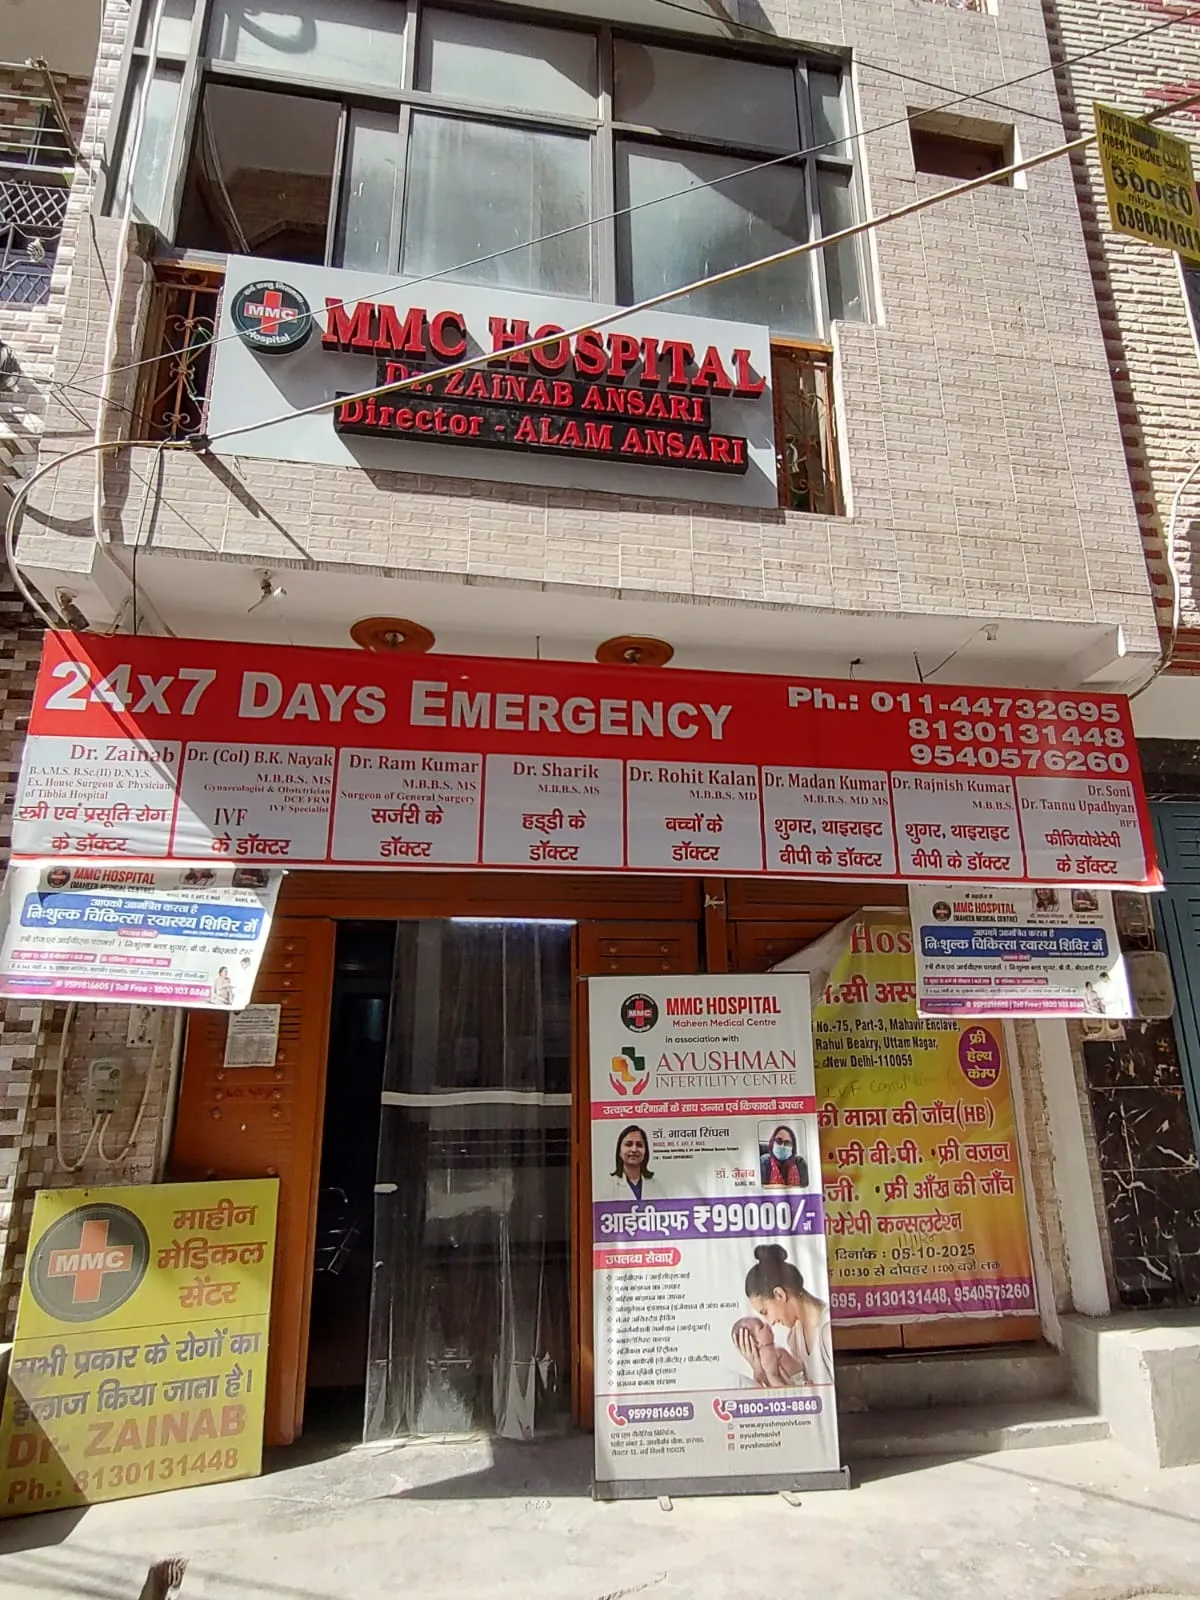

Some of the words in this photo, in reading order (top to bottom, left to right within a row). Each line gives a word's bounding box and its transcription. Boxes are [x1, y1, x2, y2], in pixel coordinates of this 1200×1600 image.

[248, 304, 294, 321] MMC
[321, 297, 467, 360] MMC
[487, 316, 766, 396] HOSPITAL
[385, 362, 433, 392] Dr.
[444, 369, 575, 407] ZAINAB
[581, 385, 705, 424] ANSARI
[338, 397, 485, 437] Director
[514, 415, 614, 452] ALAM
[620, 427, 744, 465] ANSARI
[45, 661, 217, 715] 24x7
[238, 671, 387, 724] DAYS
[409, 679, 733, 740] EMERGENCY
[788, 685, 859, 711] Ph.:
[870, 690, 1121, 724] 011-44732695
[908, 717, 1126, 749] 8130131448
[69, 744, 99, 761] Dr.
[104, 745, 175, 763] Zainab
[187, 748, 209, 762] Dr.
[213, 748, 250, 766] (Col)
[254, 751, 283, 765] B.K.
[287, 752, 333, 769] Nayak
[349, 754, 373, 769] Dr.
[378, 755, 417, 771] Ram
[421, 757, 479, 773] Kumar
[910, 742, 1130, 774] 9540576260
[513, 761, 537, 776] Dr.
[541, 762, 600, 779] Sharik
[629, 766, 653, 782] Dr.
[657, 768, 705, 784] Rohit
[708, 770, 757, 787] Kalan
[45, 778, 74, 788] House
[764, 772, 785, 787] Dr.
[788, 773, 836, 789] Madan
[839, 775, 887, 791] Kumar
[892, 777, 911, 789] Dr.
[914, 778, 964, 793] Rajnish
[967, 779, 1012, 794] Kumar
[1087, 785, 1105, 797] Dr.
[1106, 785, 1131, 798] Soni
[340, 790, 382, 801] Surgeon
[396, 791, 436, 802] General
[1021, 798, 1038, 810] Dr.
[1039, 799, 1077, 811] Tannu
[132, 804, 169, 822] रोग
[213, 808, 249, 826] IVF
[370, 802, 421, 824] सर्जरी
[425, 805, 444, 825] के
[522, 808, 564, 835] हड्डी
[568, 809, 587, 829] के
[665, 812, 705, 833] बच्चों
[705, 813, 724, 833] के
[52, 831, 74, 851] के
[73, 832, 130, 852] डॉक्टर
[236, 833, 292, 855] डॉक्टर
[380, 836, 433, 857] डॉक्टर
[529, 840, 580, 861] डॉक्टर
[671, 841, 720, 861] डॉक्टर
[815, 845, 833, 866] के
[836, 847, 883, 867] डॉक्टर
[946, 849, 963, 869] के
[966, 851, 1011, 870] डॉक्टर
[1056, 854, 1072, 873] के
[1075, 855, 1118, 874] डॉक्टर
[73, 867, 102, 882] MMC
[103, 868, 156, 885] HOSPITAL
[952, 902, 974, 914] MMC
[974, 902, 1016, 914] HOSPITAL
[83, 907, 144, 927] चिकित्सा
[147, 912, 198, 930] स्वास्थ्य
[199, 913, 239, 935] शिविर
[924, 936, 970, 954] निःशुल्क
[971, 938, 1018, 952] चिकित्सा
[1019, 939, 1058, 951] स्वास्थ्य
[1058, 937, 1089, 952] शिविर
[1090, 938, 1104, 951] में
[628, 1009, 652, 1017] MMC
[666, 998, 704, 1016] MMC
[706, 996, 781, 1015] HOSPITAL
[672, 1018, 709, 1028] Maheen
[710, 1018, 745, 1027] Medical
[746, 1018, 777, 1027] Centre
[855, 1019, 888, 1033] Part-3,
[889, 1018, 924, 1031] Mahavir
[924, 1019, 961, 1033] Enclave,
[665, 1036, 674, 1044] in
[674, 1035, 721, 1043] association
[721, 1034, 740, 1043] with
[815, 1037, 844, 1050] Rahul
[846, 1037, 882, 1052] Beakry,
[883, 1036, 910, 1049] Uttam
[911, 1037, 938, 1051] Nagar,
[656, 1049, 797, 1072] AYUSHMAN
[825, 1055, 848, 1068] New
[849, 1053, 913, 1068] Delhi-110059
[655, 1075, 738, 1089] INFERTILITY
[742, 1073, 797, 1087] CENTRE
[891, 1100, 918, 1125] की
[652, 1127, 667, 1140] डॉ.
[668, 1129, 698, 1139] भावना
[699, 1126, 730, 1139] सिंघला
[837, 1140, 865, 1169] फ्री
[937, 1138, 960, 1165] फ्री
[963, 1143, 1010, 1162] वजन
[714, 1167, 730, 1179] डॉ.
[883, 1174, 909, 1202] फ्री
[912, 1173, 950, 1199] आँख
[952, 1171, 976, 1196] की
[172, 1198, 258, 1231] माहीन
[599, 1205, 690, 1237] आईवीएफ
[693, 1199, 816, 1233] ₹99000/-
[54, 1250, 125, 1272] MMC
[157, 1236, 268, 1270] मेडिकल
[892, 1244, 976, 1261] 05-10-2025
[838, 1268, 870, 1278] 10:30
[874, 1265, 885, 1276] से
[889, 1264, 928, 1275] दोपहर
[932, 1263, 954, 1273] 1:00
[866, 1287, 951, 1308] 8130131448,
[74, 1346, 141, 1379] प्रकार
[144, 1335, 171, 1366] के
[176, 1327, 229, 1362] रोगों
[230, 1331, 262, 1355] का
[12, 1391, 91, 1427] इलाज
[97, 1378, 158, 1413] किया
[163, 1374, 221, 1402] जाता
[738, 1399, 819, 1415] 1800-103-8868
[627, 1406, 690, 1420] 9599816605
[83, 1403, 247, 1458] ZAINAB
[7, 1477, 62, 1505] Ph.:
[72, 1447, 239, 1494] 8130131448
